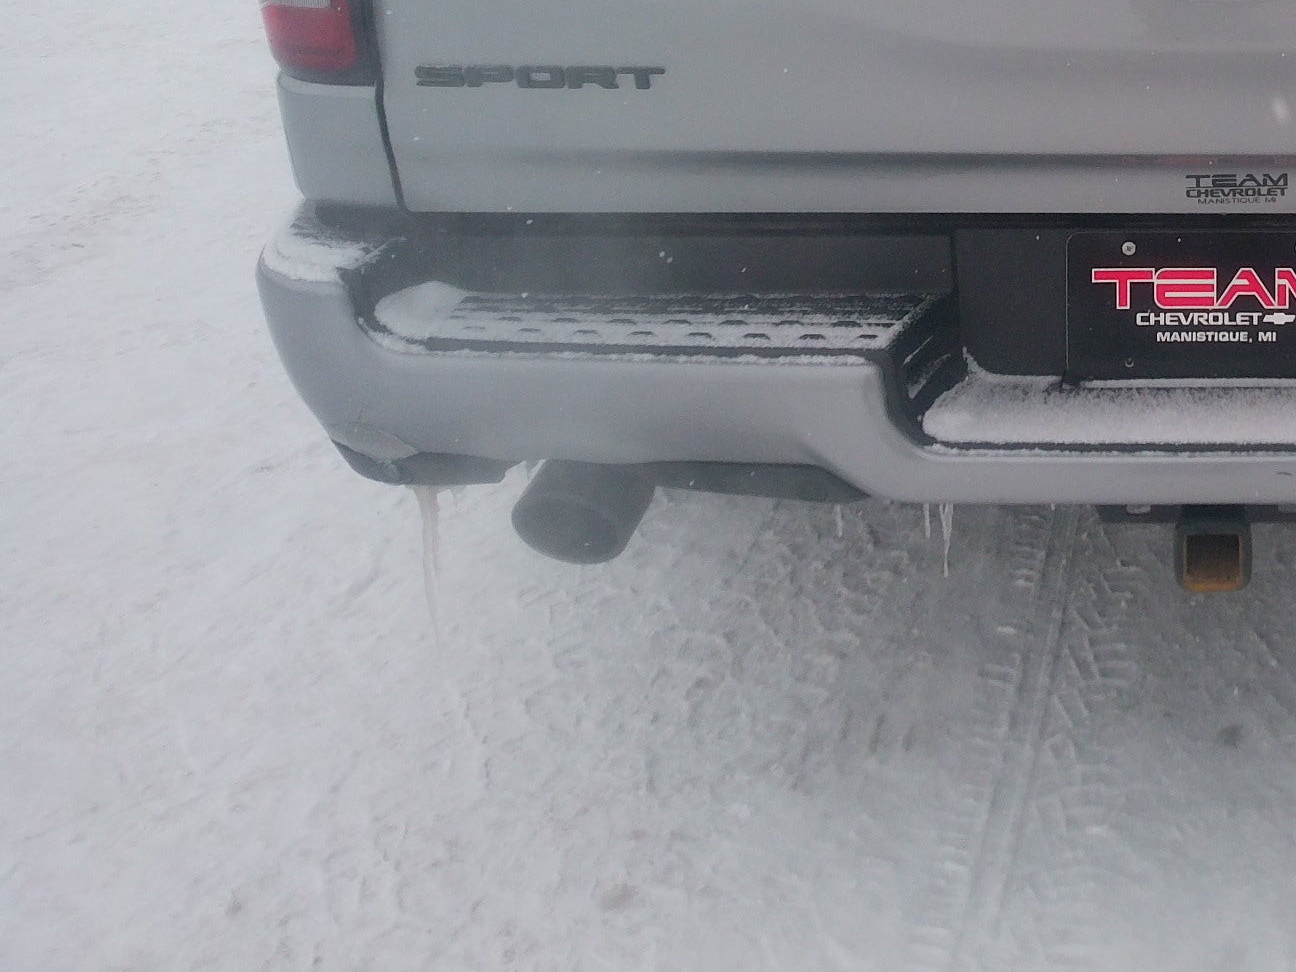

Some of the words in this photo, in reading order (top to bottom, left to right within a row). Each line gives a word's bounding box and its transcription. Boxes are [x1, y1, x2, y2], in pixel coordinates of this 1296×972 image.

[414, 65, 666, 89] SPORT
[1185, 173, 1289, 188] TEAM
[1185, 188, 1288, 198] CHEVROLET
[1197, 197, 1261, 205] MANISTIQUE
[1136, 312, 1262, 326] CHEVROLET
[1156, 331, 1253, 343] MANISTIQUE,
[1258, 331, 1277, 342] MI
